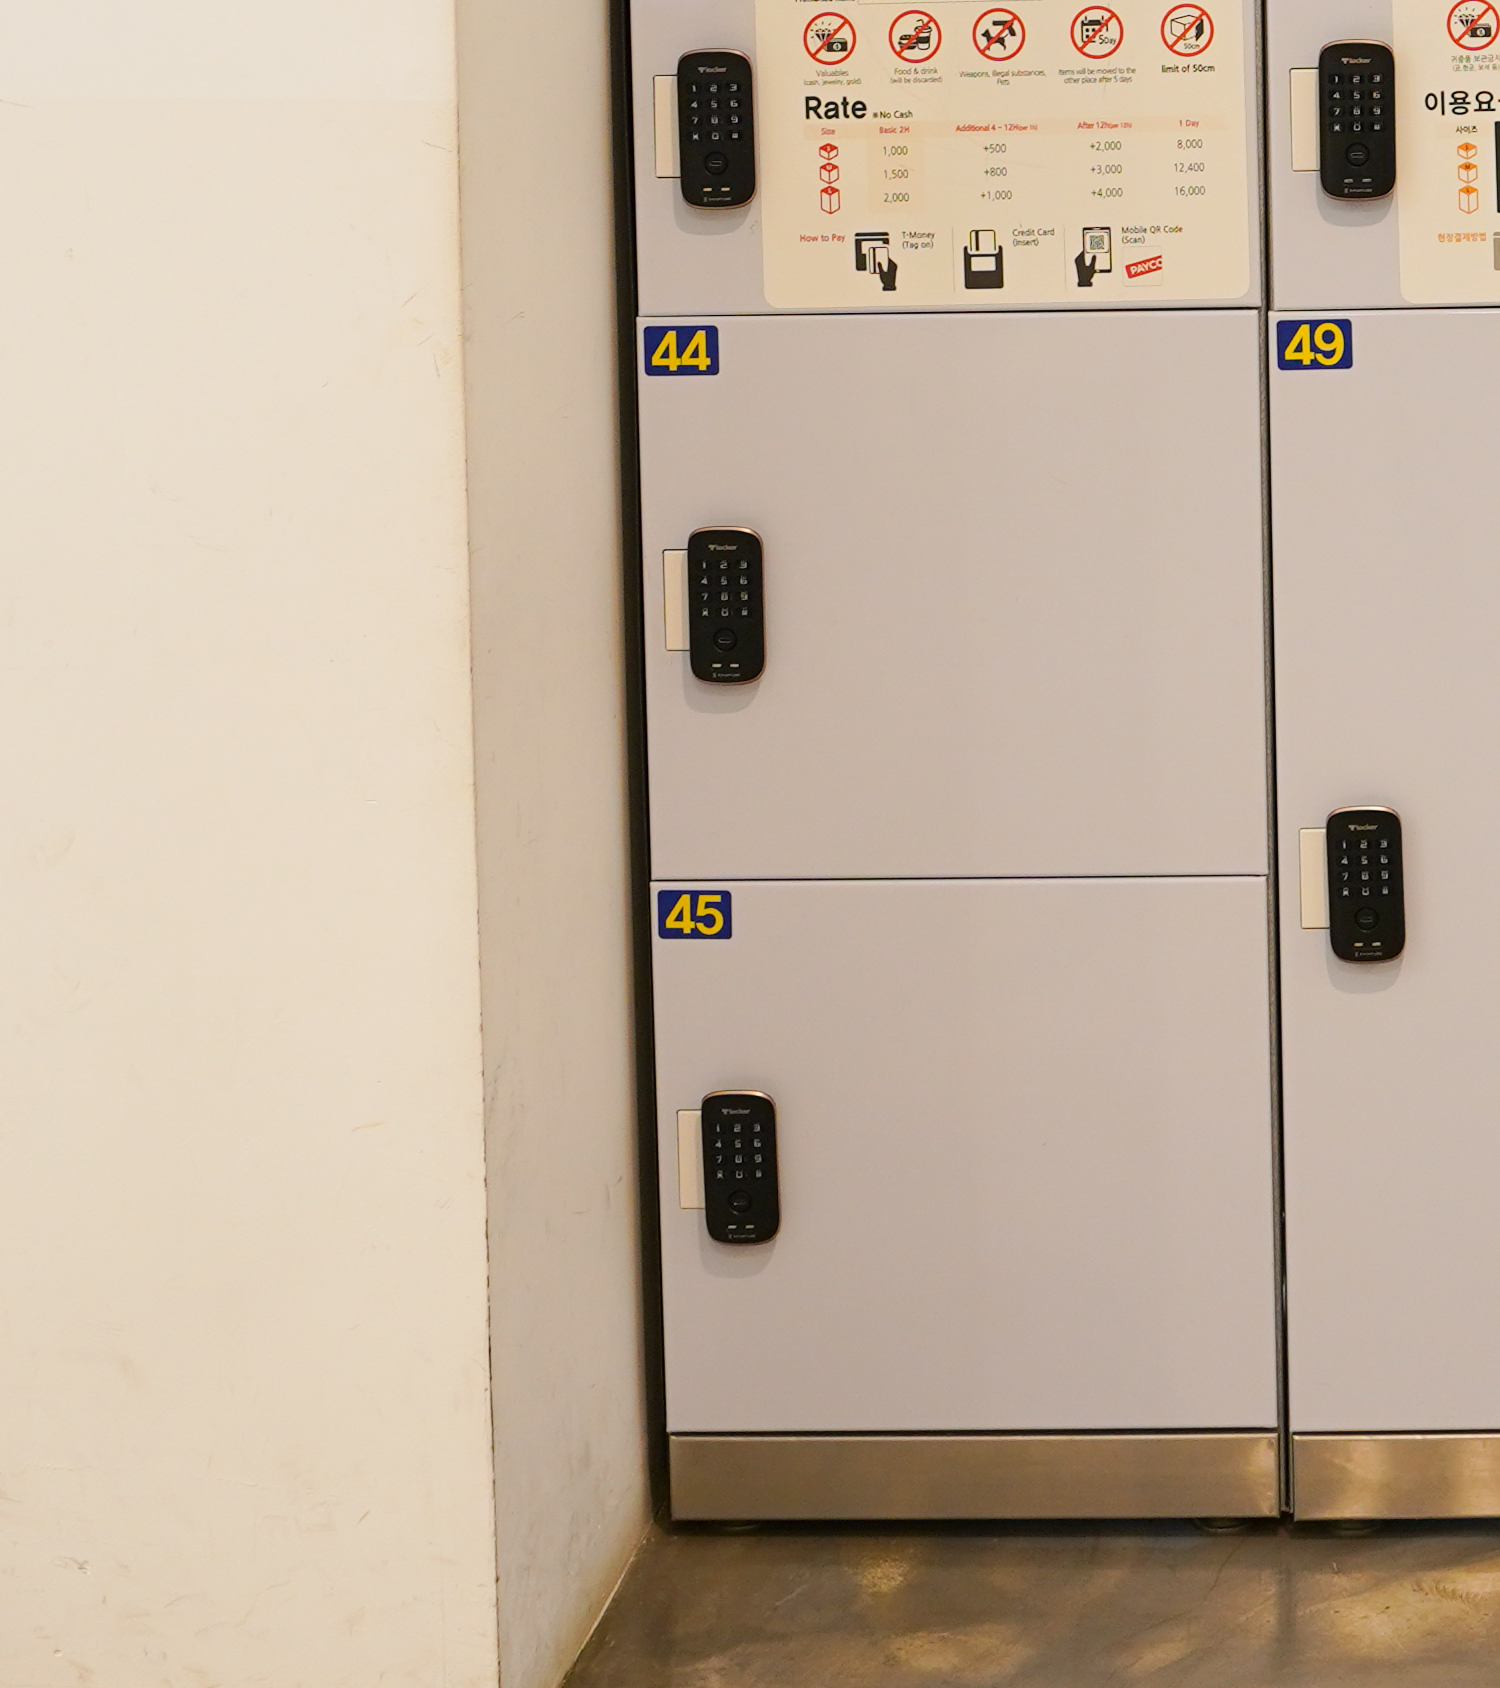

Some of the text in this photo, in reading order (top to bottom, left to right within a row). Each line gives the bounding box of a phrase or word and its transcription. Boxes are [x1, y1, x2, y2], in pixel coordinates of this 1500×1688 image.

[805, 96, 867, 120] Rate
[880, 110, 913, 119] No Cash
[983, 144, 1007, 153] +500
[1177, 139, 1203, 150] 8,000
[883, 146, 909, 156] 1,000
[1174, 163, 1205, 173] 12,400
[1175, 186, 1206, 196] 16,000
[884, 193, 910, 203] 2,000
[1284, 322, 1345, 366] 49
[651, 330, 711, 371] 44
[665, 894, 724, 935] 45
